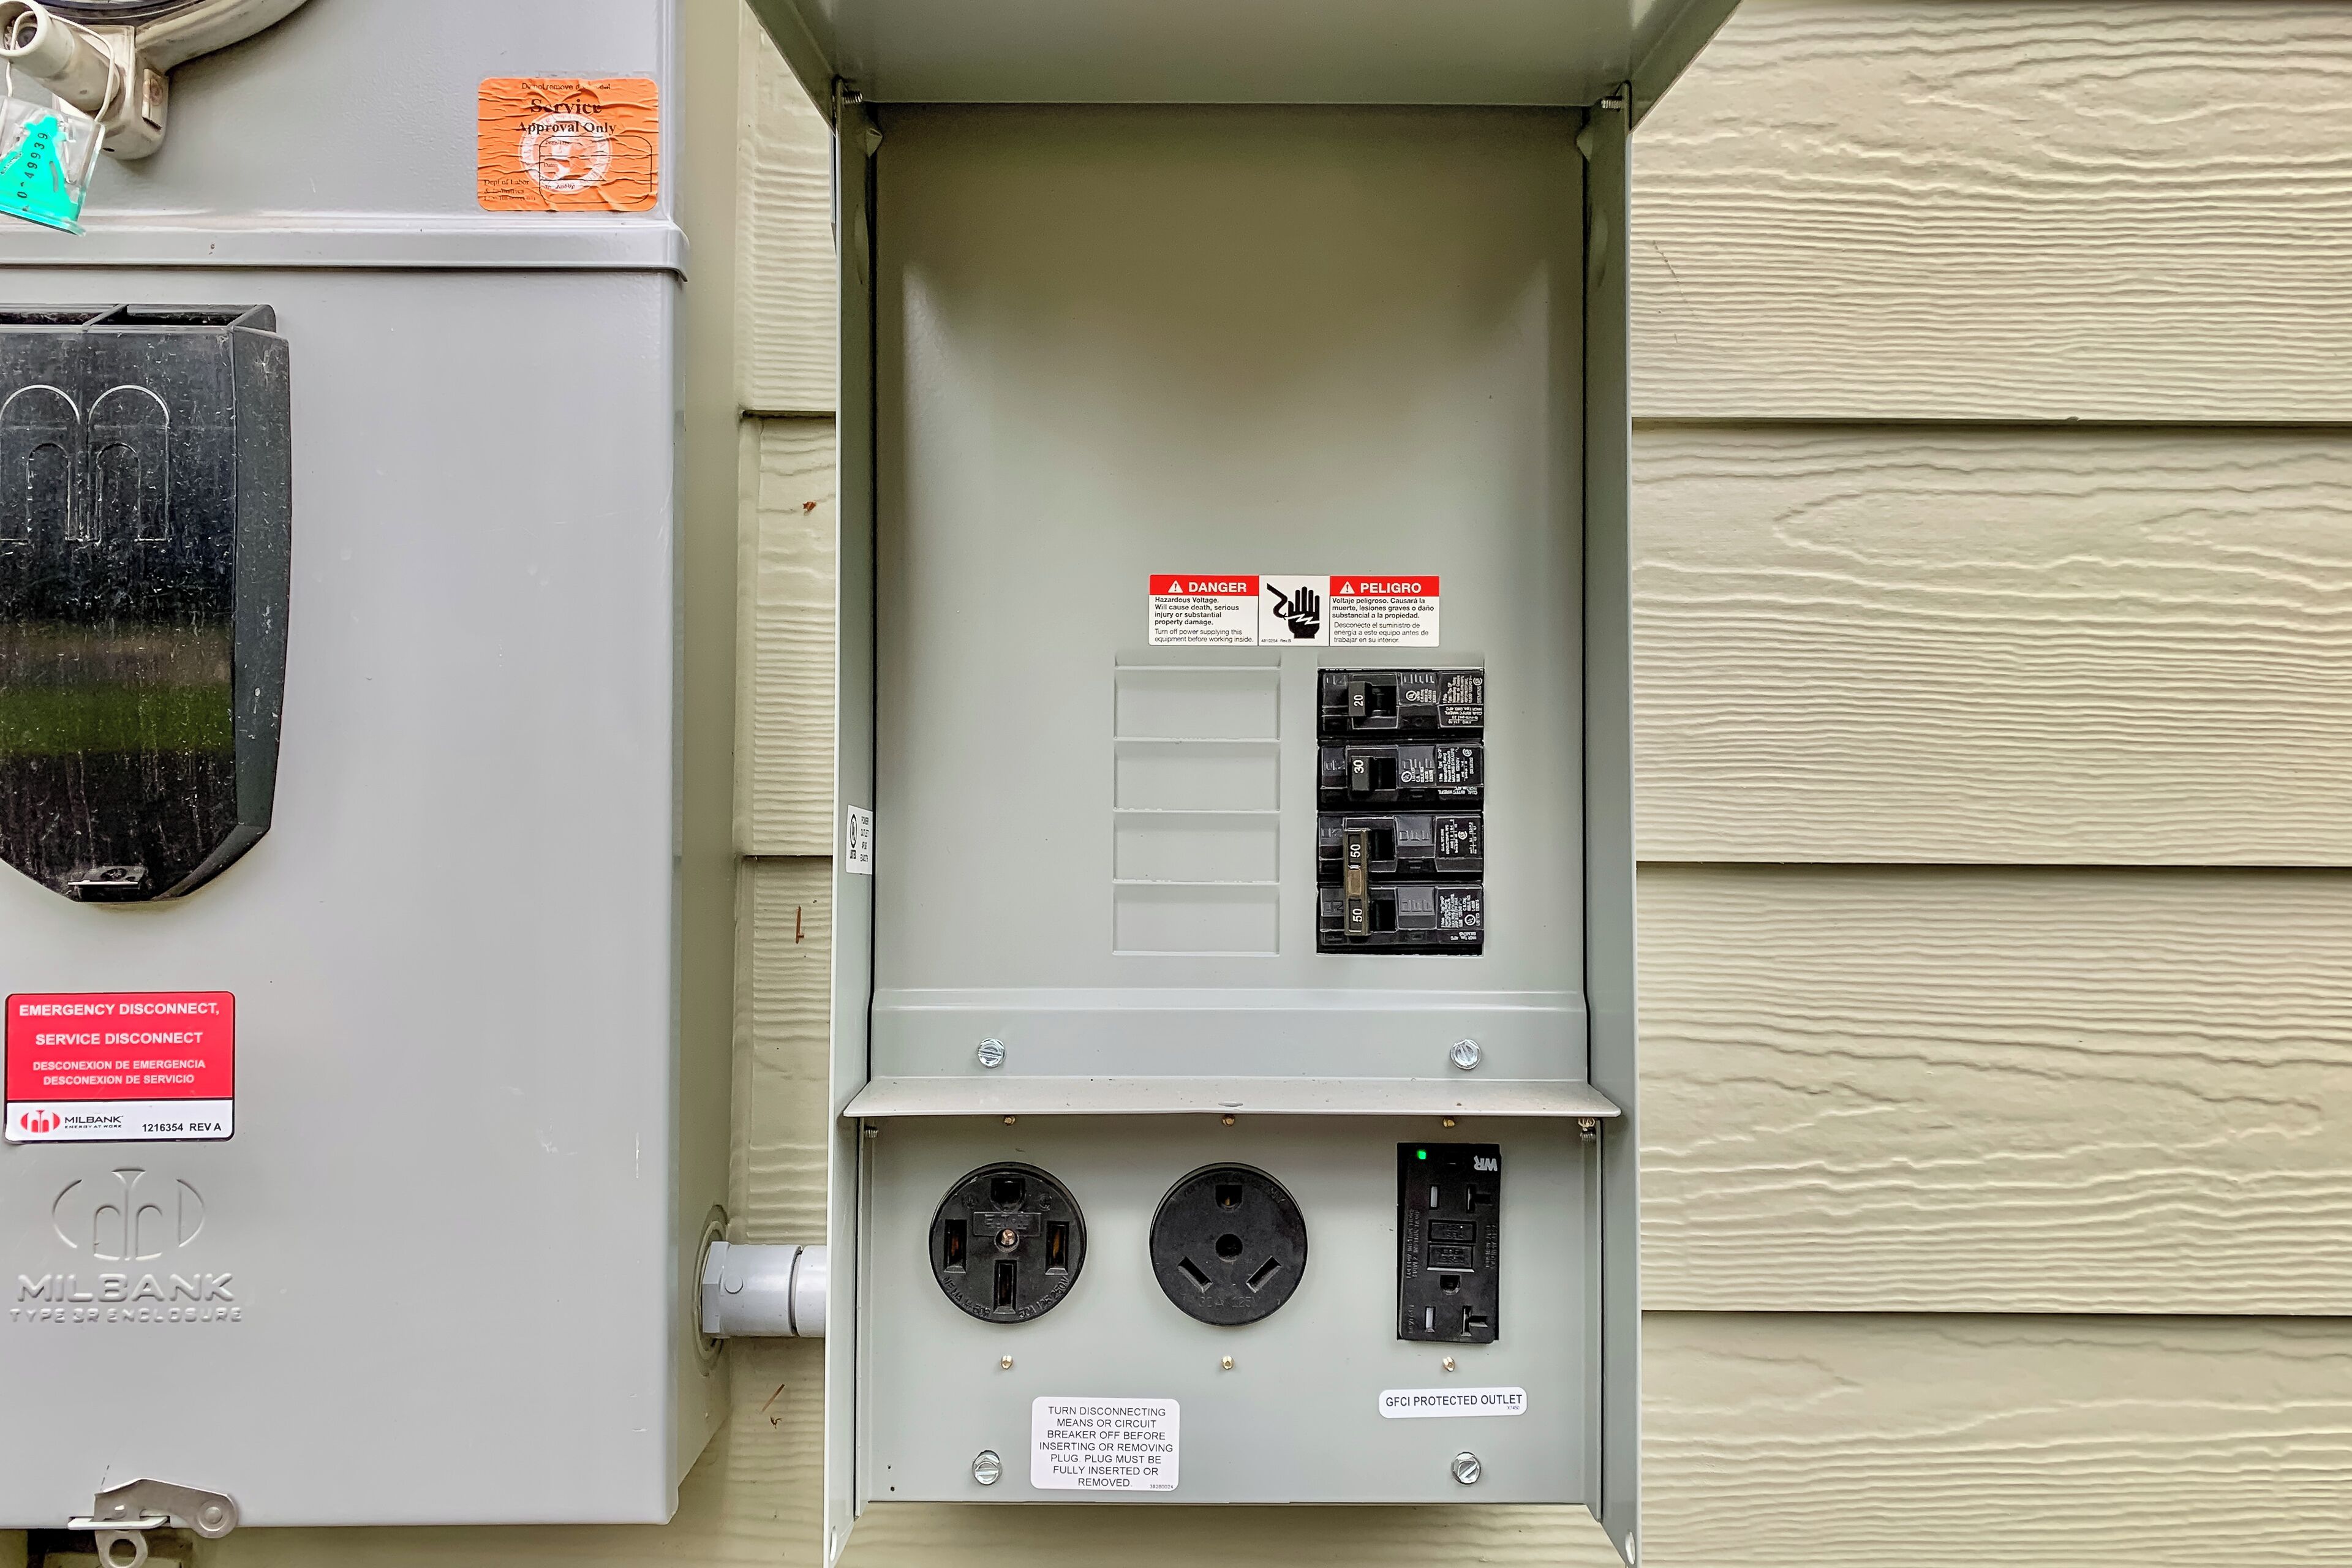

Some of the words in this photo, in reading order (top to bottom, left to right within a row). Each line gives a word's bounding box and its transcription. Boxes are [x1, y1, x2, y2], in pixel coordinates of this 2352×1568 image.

[530, 99, 602, 114] Service
[519, 122, 579, 135] Approval
[583, 123, 616, 135] Only
[1189, 582, 1247, 592] DANGER
[1360, 583, 1422, 594] PELIGRO
[1354, 695, 1363, 707] 20
[1354, 760, 1364, 774] 30
[1351, 844, 1361, 858] 50
[1352, 908, 1362, 922] 50
[19, 1004, 115, 1017] EMERGENCY
[119, 1002, 219, 1016] DISCONNECT,
[36, 1033, 100, 1046] SERVICE
[105, 1031, 203, 1045] DISCONNECT
[32, 1061, 111, 1071] DESCONEXION
[115, 1061, 130, 1069] DE
[134, 1060, 205, 1069] EMERGENCIA
[43, 1076, 122, 1085] DESCONEXION
[126, 1076, 140, 1084] DE
[143, 1074, 194, 1084] SERVICIO
[142, 1123, 183, 1132] 1216354
[189, 1123, 211, 1131] REV
[1474, 1156, 1498, 1172] WR
[17, 1273, 235, 1302] MILBANK
[10, 1308, 66, 1323] TYPE
[107, 1307, 242, 1322] ENCLOSURE
[1386, 1396, 1410, 1406] GFCI
[1414, 1395, 1477, 1406] PROTECTED
[1480, 1395, 1522, 1404] OUTLET
[1048, 1406, 1076, 1415] TURN
[1080, 1407, 1166, 1416] DISCONNECTING
[1047, 1430, 1096, 1439] BREAKER
[1040, 1442, 1095, 1450] INSERTING
[1117, 1444, 1173, 1452] REMOVING
[1078, 1478, 1132, 1487] REMOVED.
